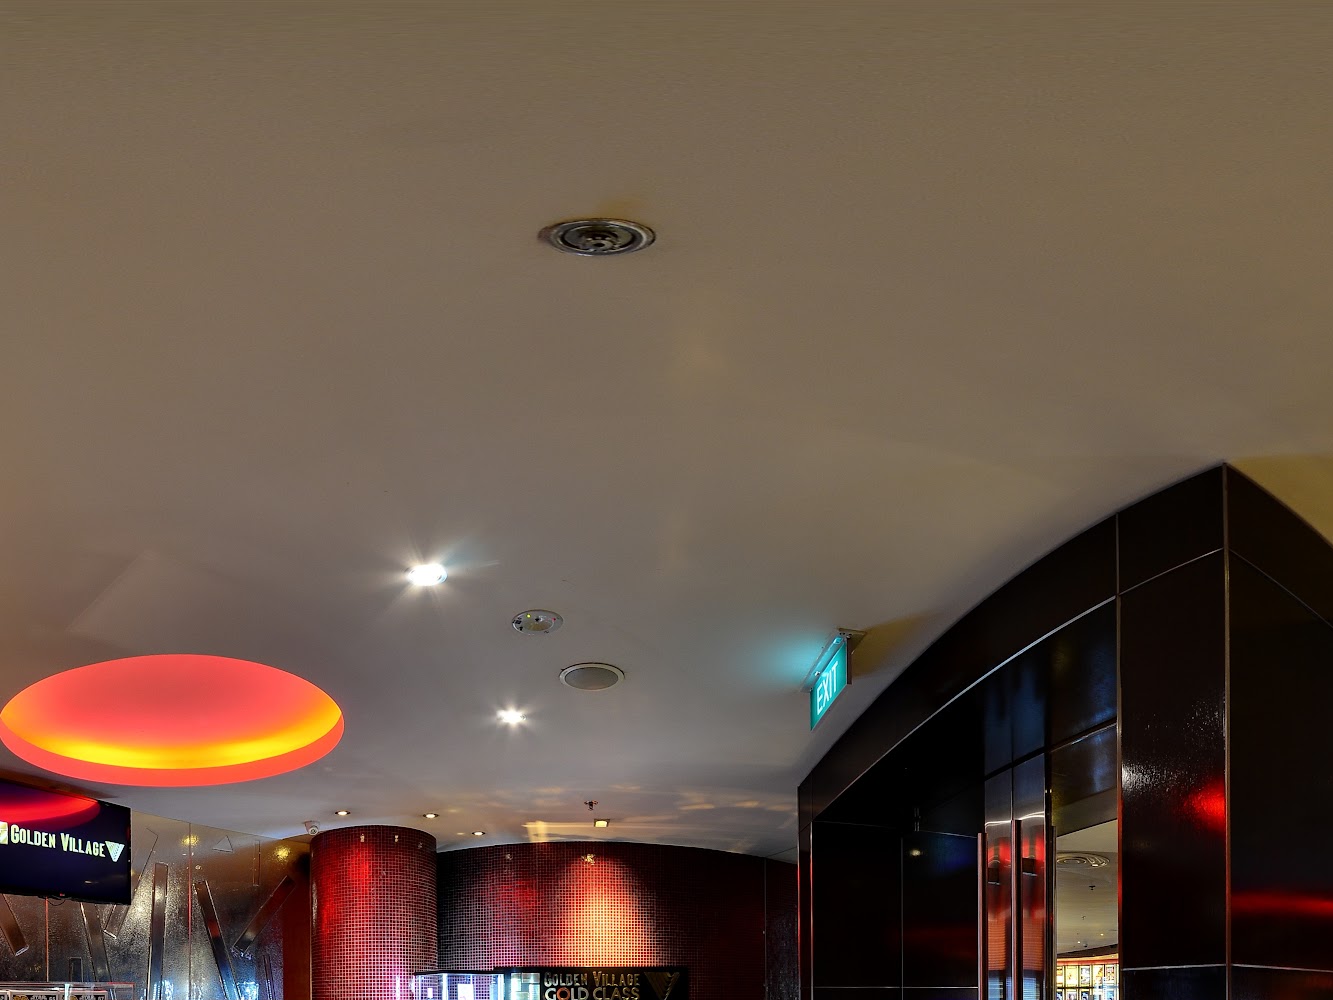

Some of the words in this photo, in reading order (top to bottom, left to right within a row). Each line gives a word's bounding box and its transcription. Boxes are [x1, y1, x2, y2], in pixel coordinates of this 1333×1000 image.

[816, 661, 838, 715] EXIT
[10, 824, 56, 849] GOLDEN
[60, 832, 106, 858] VILLAGE
[544, 971, 588, 987] GOLDEN
[592, 970, 640, 987] VILLAGE
